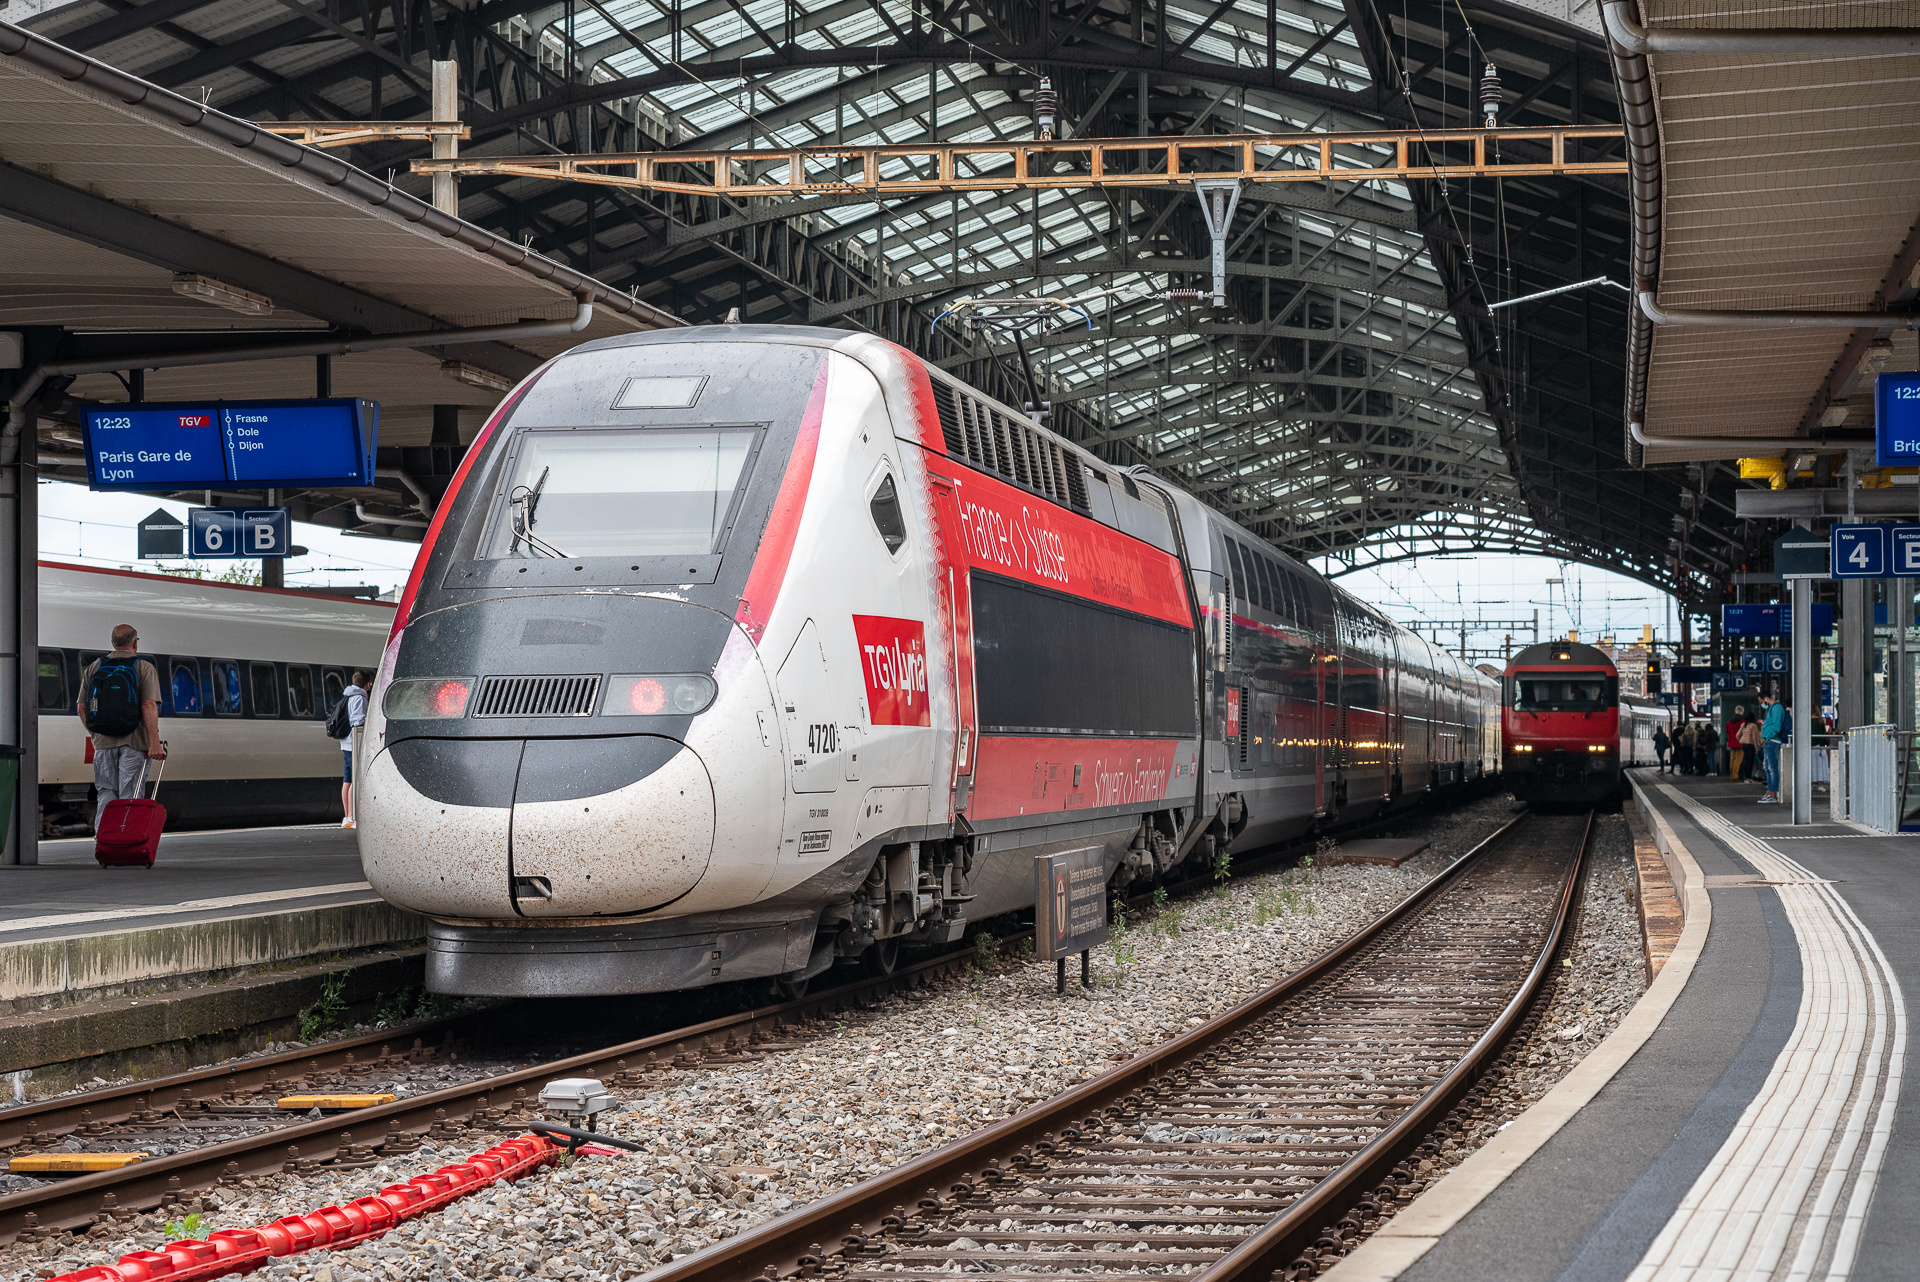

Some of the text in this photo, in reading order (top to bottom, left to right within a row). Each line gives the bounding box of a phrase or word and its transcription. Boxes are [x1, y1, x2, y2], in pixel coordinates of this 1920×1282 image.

[95, 416, 202, 429] 12:23 TGV
[235, 414, 268, 423] Frasne
[237, 428, 259, 436] Dole
[239, 441, 264, 451] Dijon
[100, 449, 192, 463] Paris Gare de
[101, 467, 134, 481] Lyon
[205, 524, 276, 551] 6 B
[953, 478, 1011, 567] France
[1022, 505, 1069, 584] Suisse
[1849, 542, 1869, 568] 4
[864, 644, 897, 690] TGV
[1748, 657, 1783, 670] 4 C
[1717, 678, 1744, 688] 4 D
[808, 723, 836, 754] 4720
